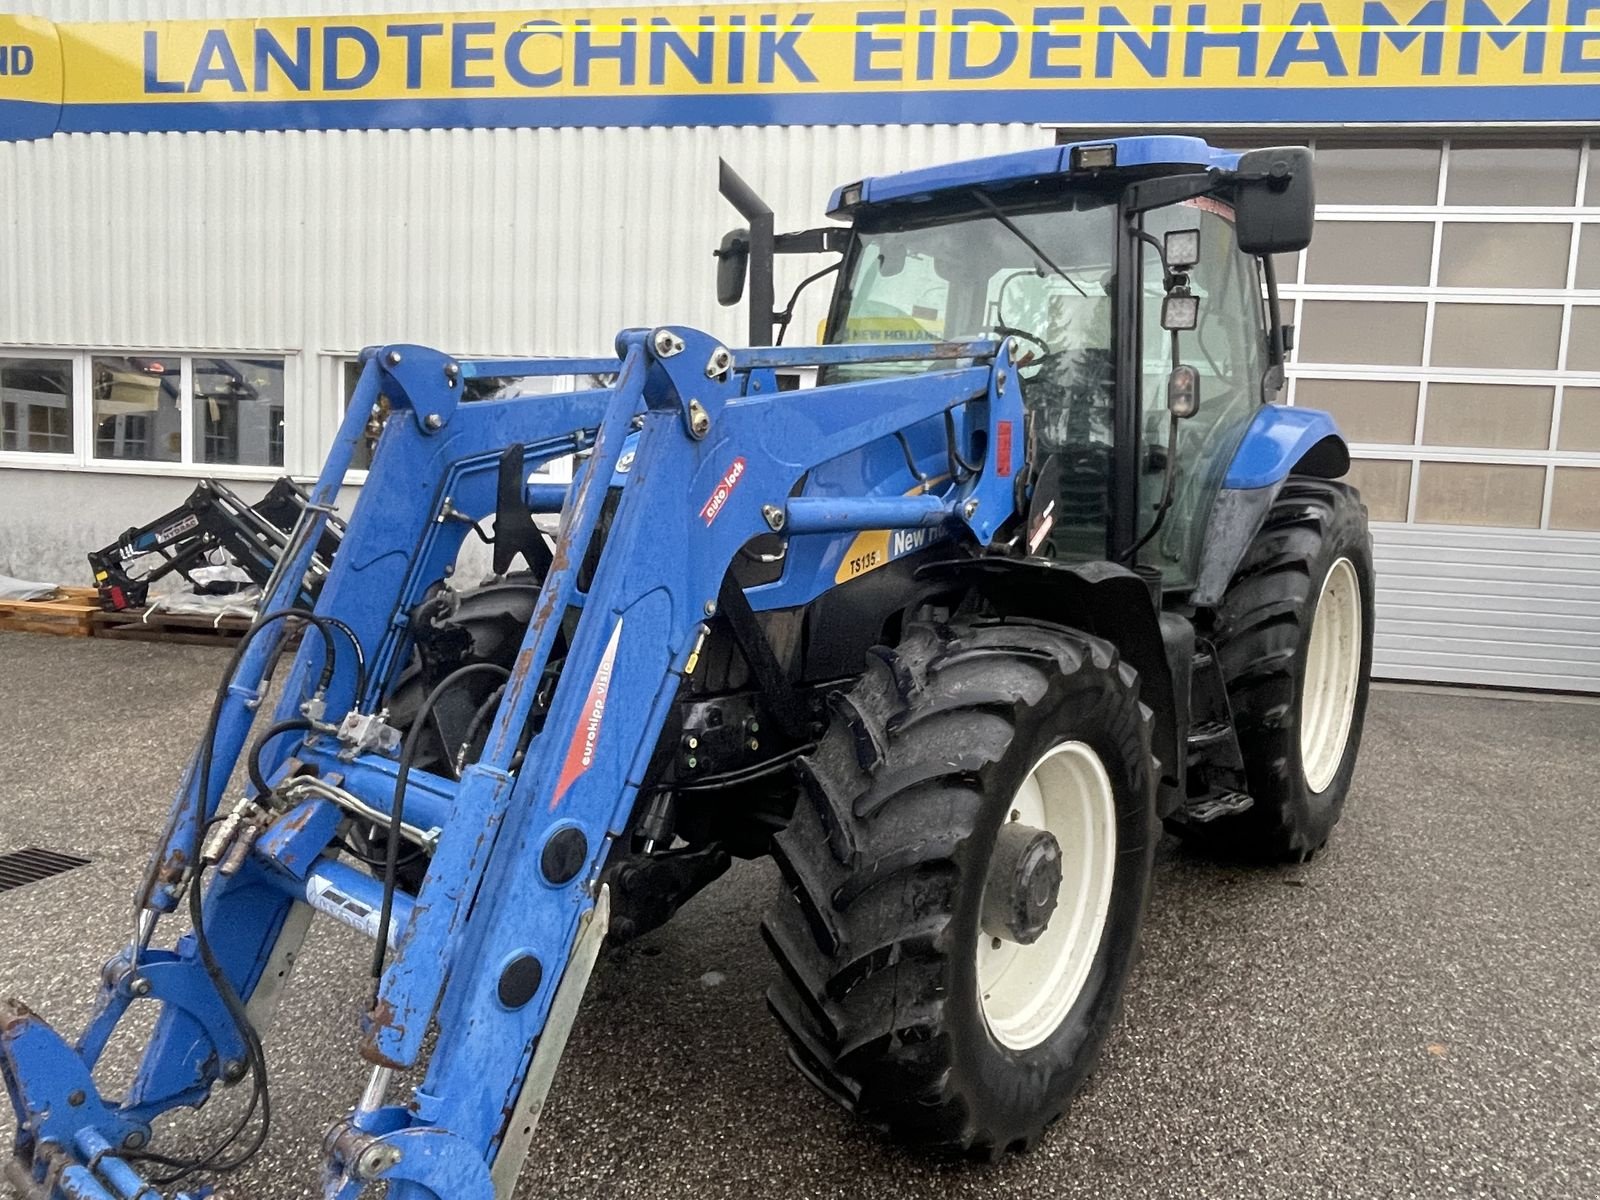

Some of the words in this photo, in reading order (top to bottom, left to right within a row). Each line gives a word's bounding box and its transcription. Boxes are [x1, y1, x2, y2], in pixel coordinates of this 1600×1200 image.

[143, 12, 819, 94] LANDTECHNIK
[853, 0, 1600, 82] EIDENHAMME
[706, 489, 726, 518] auto
[724, 461, 744, 488] lock
[894, 528, 926, 557] New
[581, 698, 605, 767] eurokipp
[596, 661, 611, 695] visio
